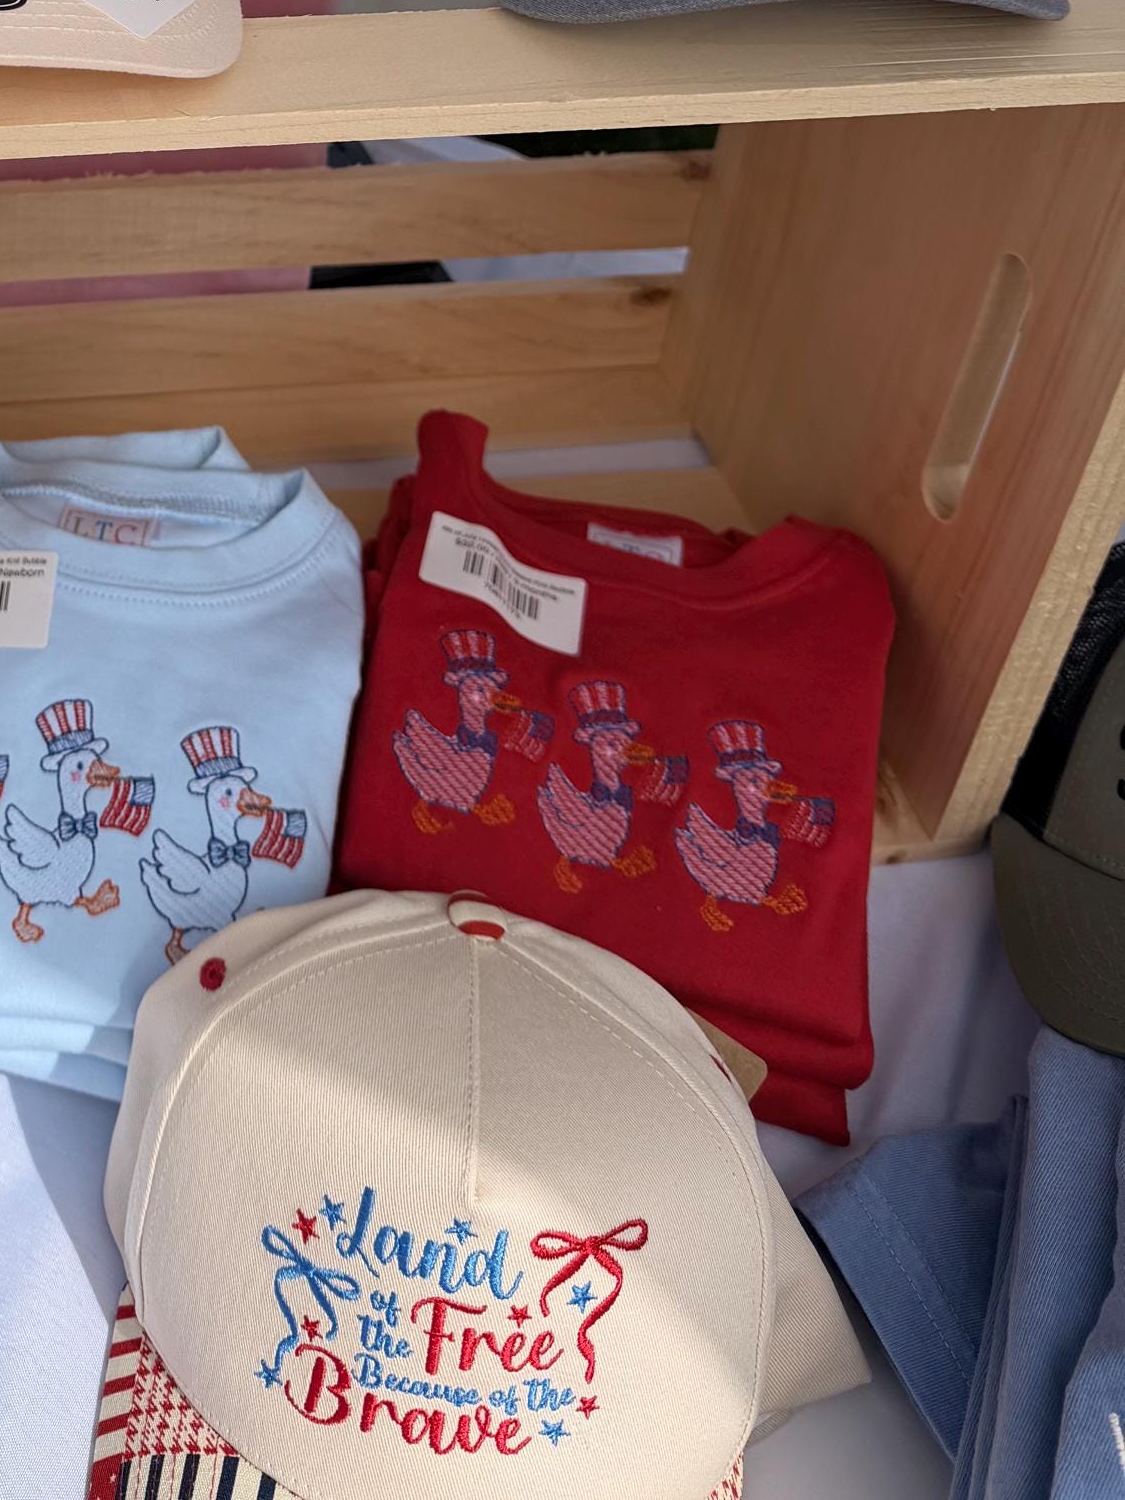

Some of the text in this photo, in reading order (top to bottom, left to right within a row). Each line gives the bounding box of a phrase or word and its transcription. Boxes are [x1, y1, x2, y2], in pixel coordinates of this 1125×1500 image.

[336, 1186, 524, 1300] Land
[357, 1296, 565, 1376] the Free
[370, 1290, 401, 1328] of
[284, 1343, 533, 1456] Brave
[352, 1352, 577, 1416] Because of the
